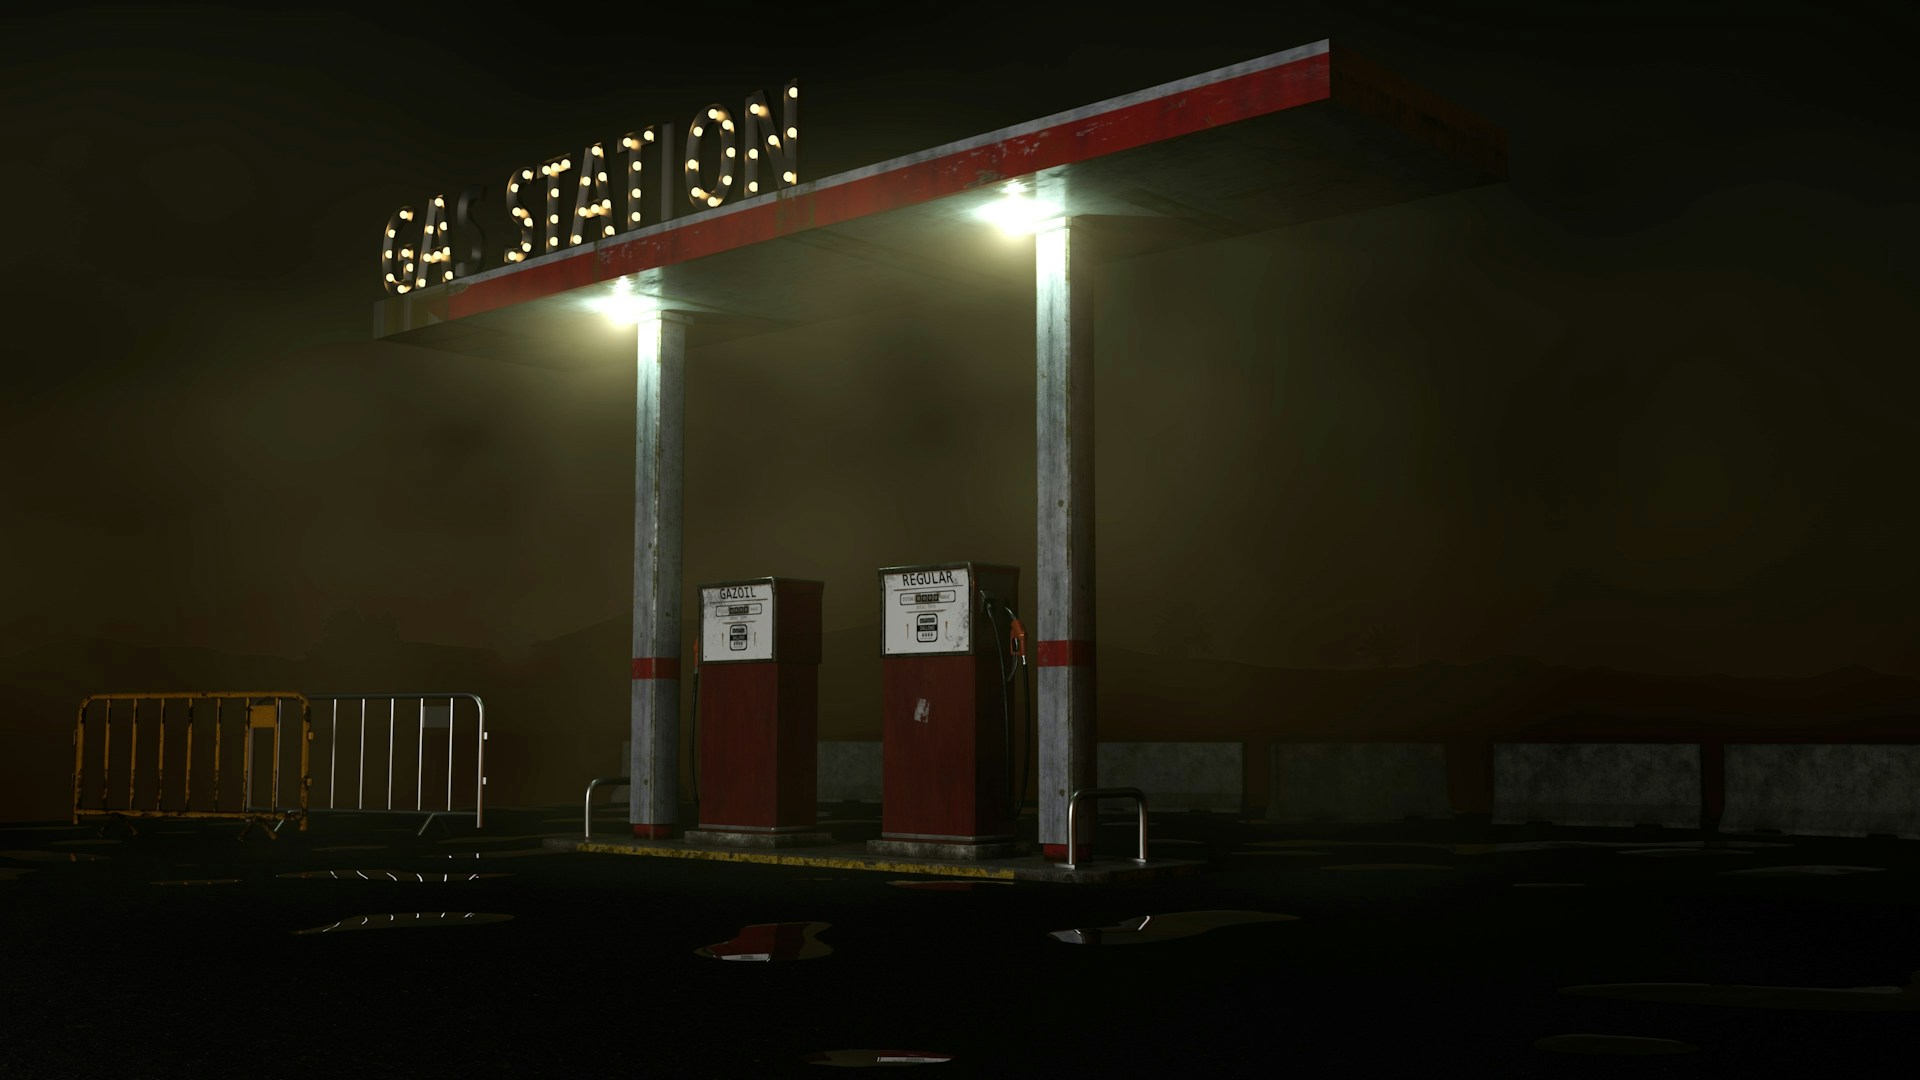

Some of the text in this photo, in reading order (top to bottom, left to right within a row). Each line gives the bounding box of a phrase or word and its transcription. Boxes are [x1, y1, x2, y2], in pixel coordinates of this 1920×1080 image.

[381, 77, 800, 296] GAS STATION
[902, 571, 953, 586] REGULAR
[720, 586, 756, 599] GAZOIL
